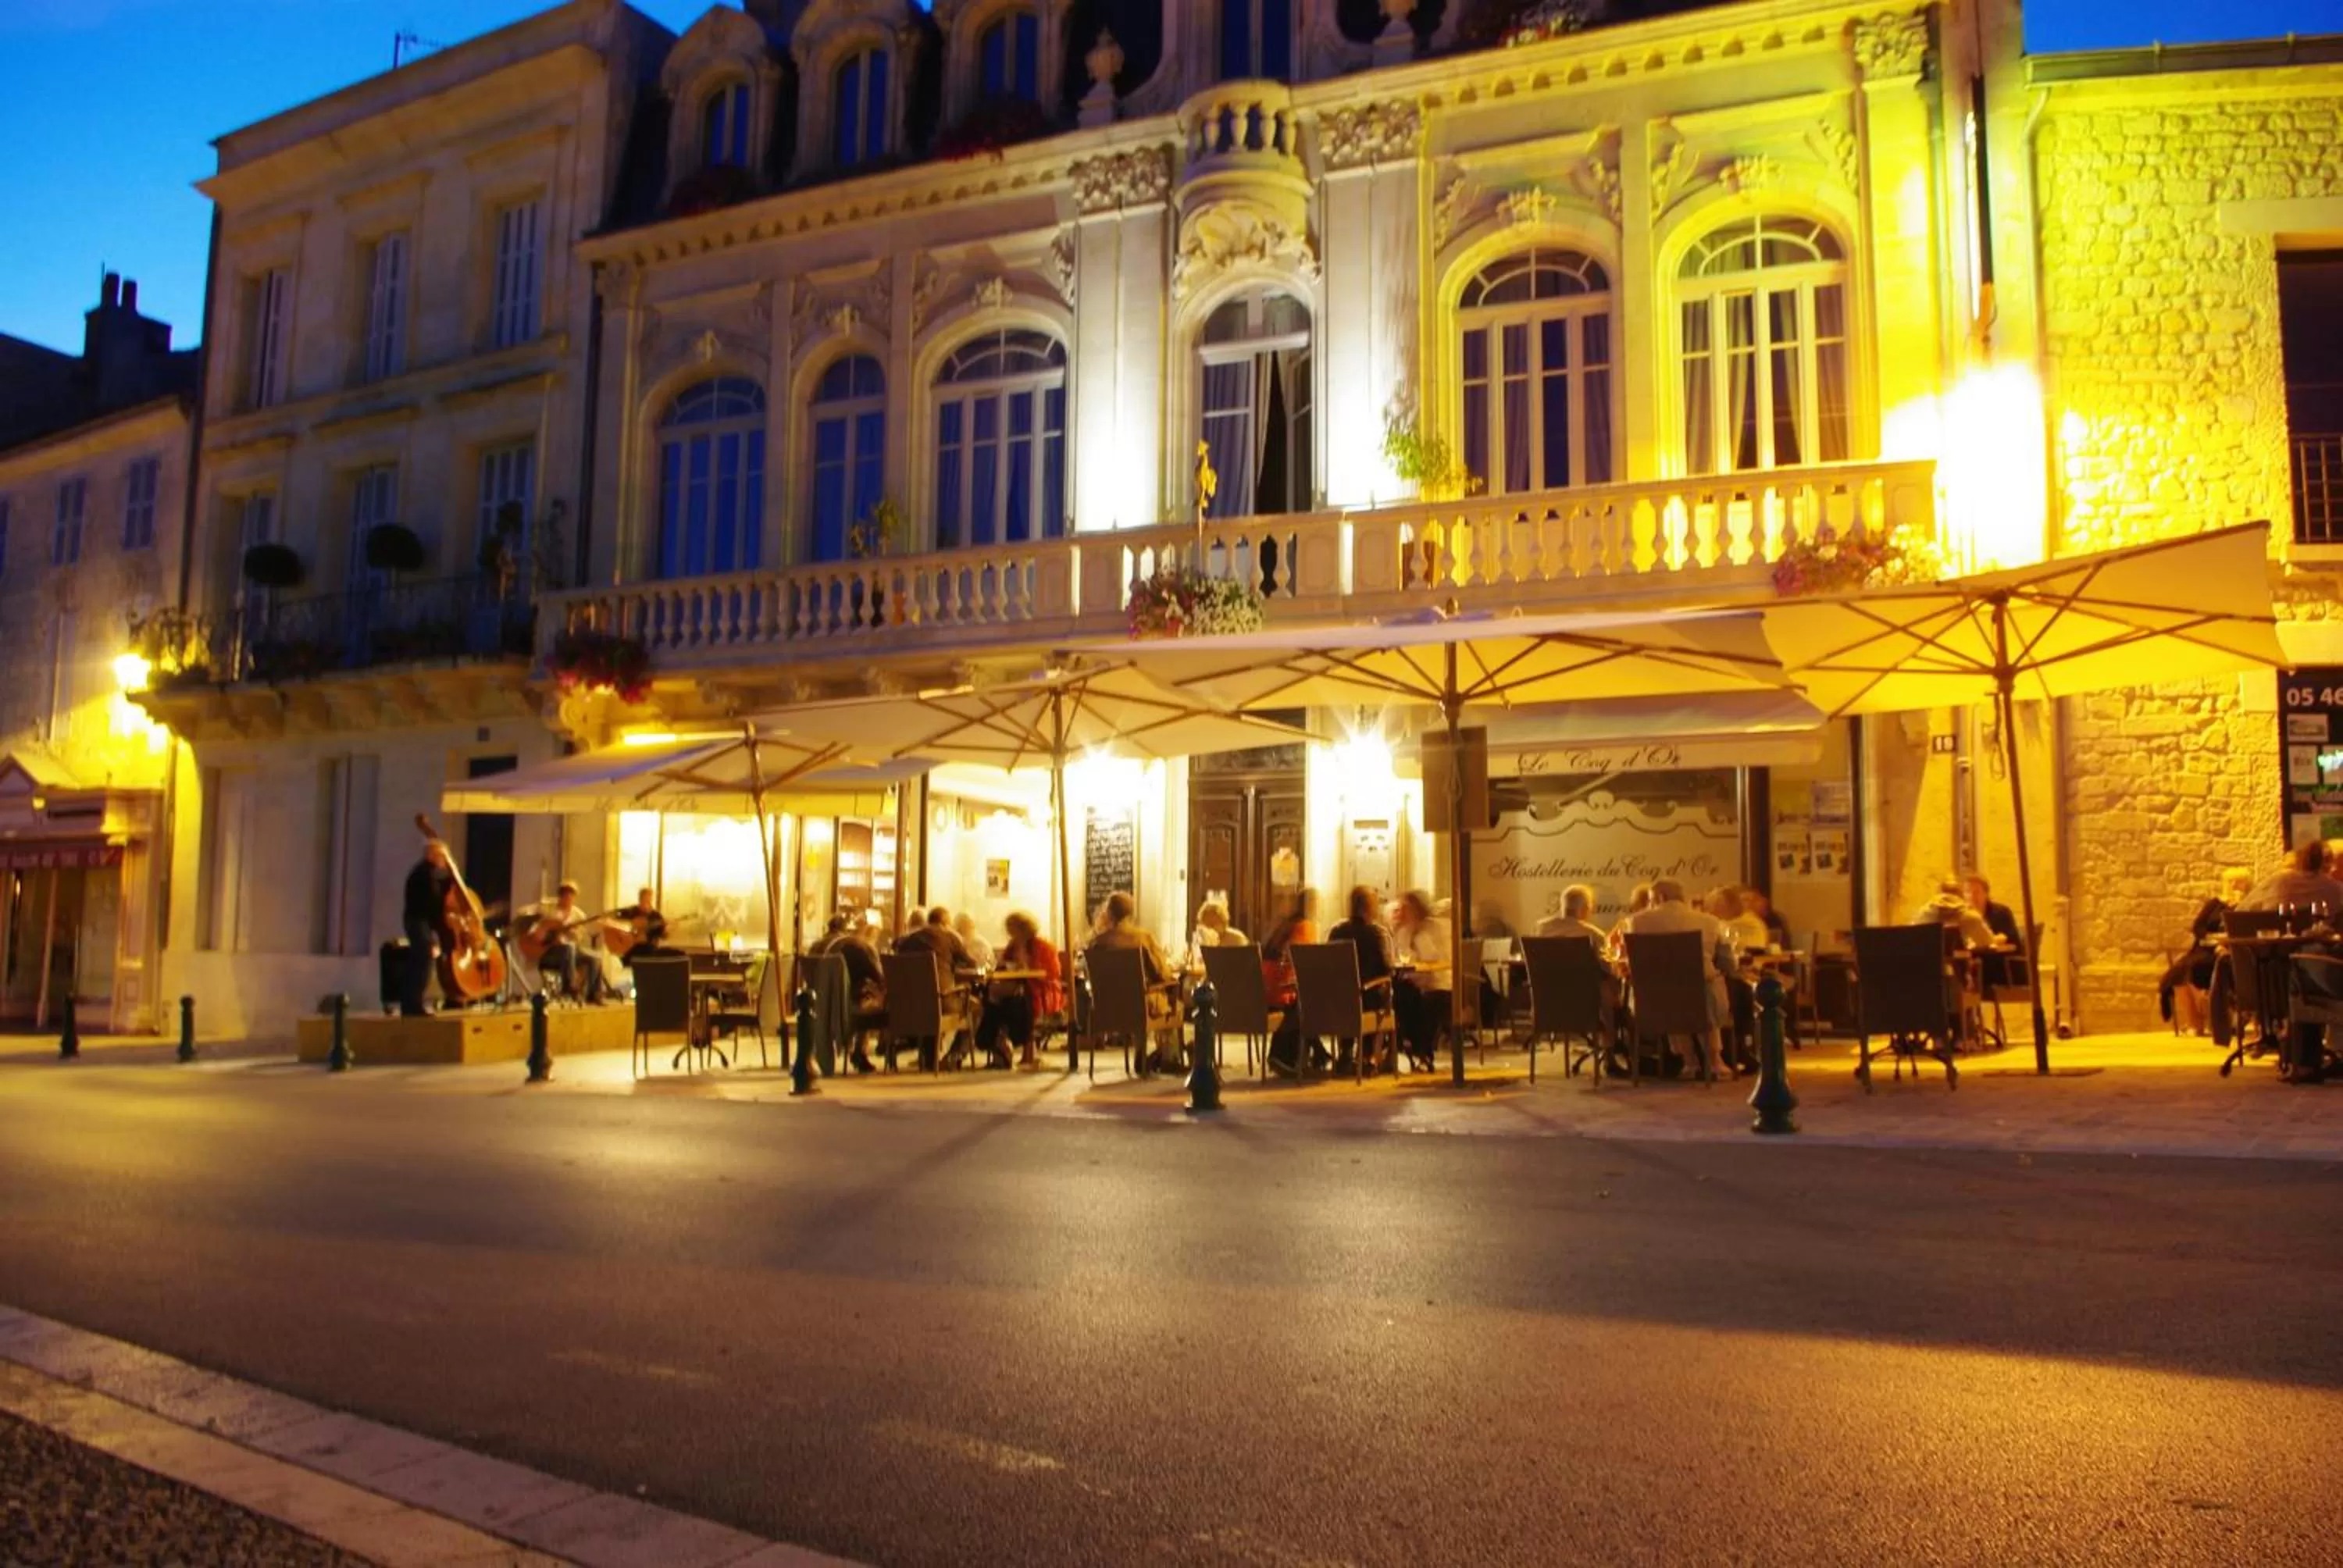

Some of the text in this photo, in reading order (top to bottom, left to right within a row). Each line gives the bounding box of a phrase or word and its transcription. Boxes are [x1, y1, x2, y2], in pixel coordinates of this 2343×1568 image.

[2287, 687, 2343, 706] 05 46
[1517, 751, 1548, 775] Le
[1564, 747, 1610, 775] Coq
[1488, 854, 1593, 878] Hostellerie
[1596, 856, 1620, 877] du
[1621, 853, 1661, 882] Coq
